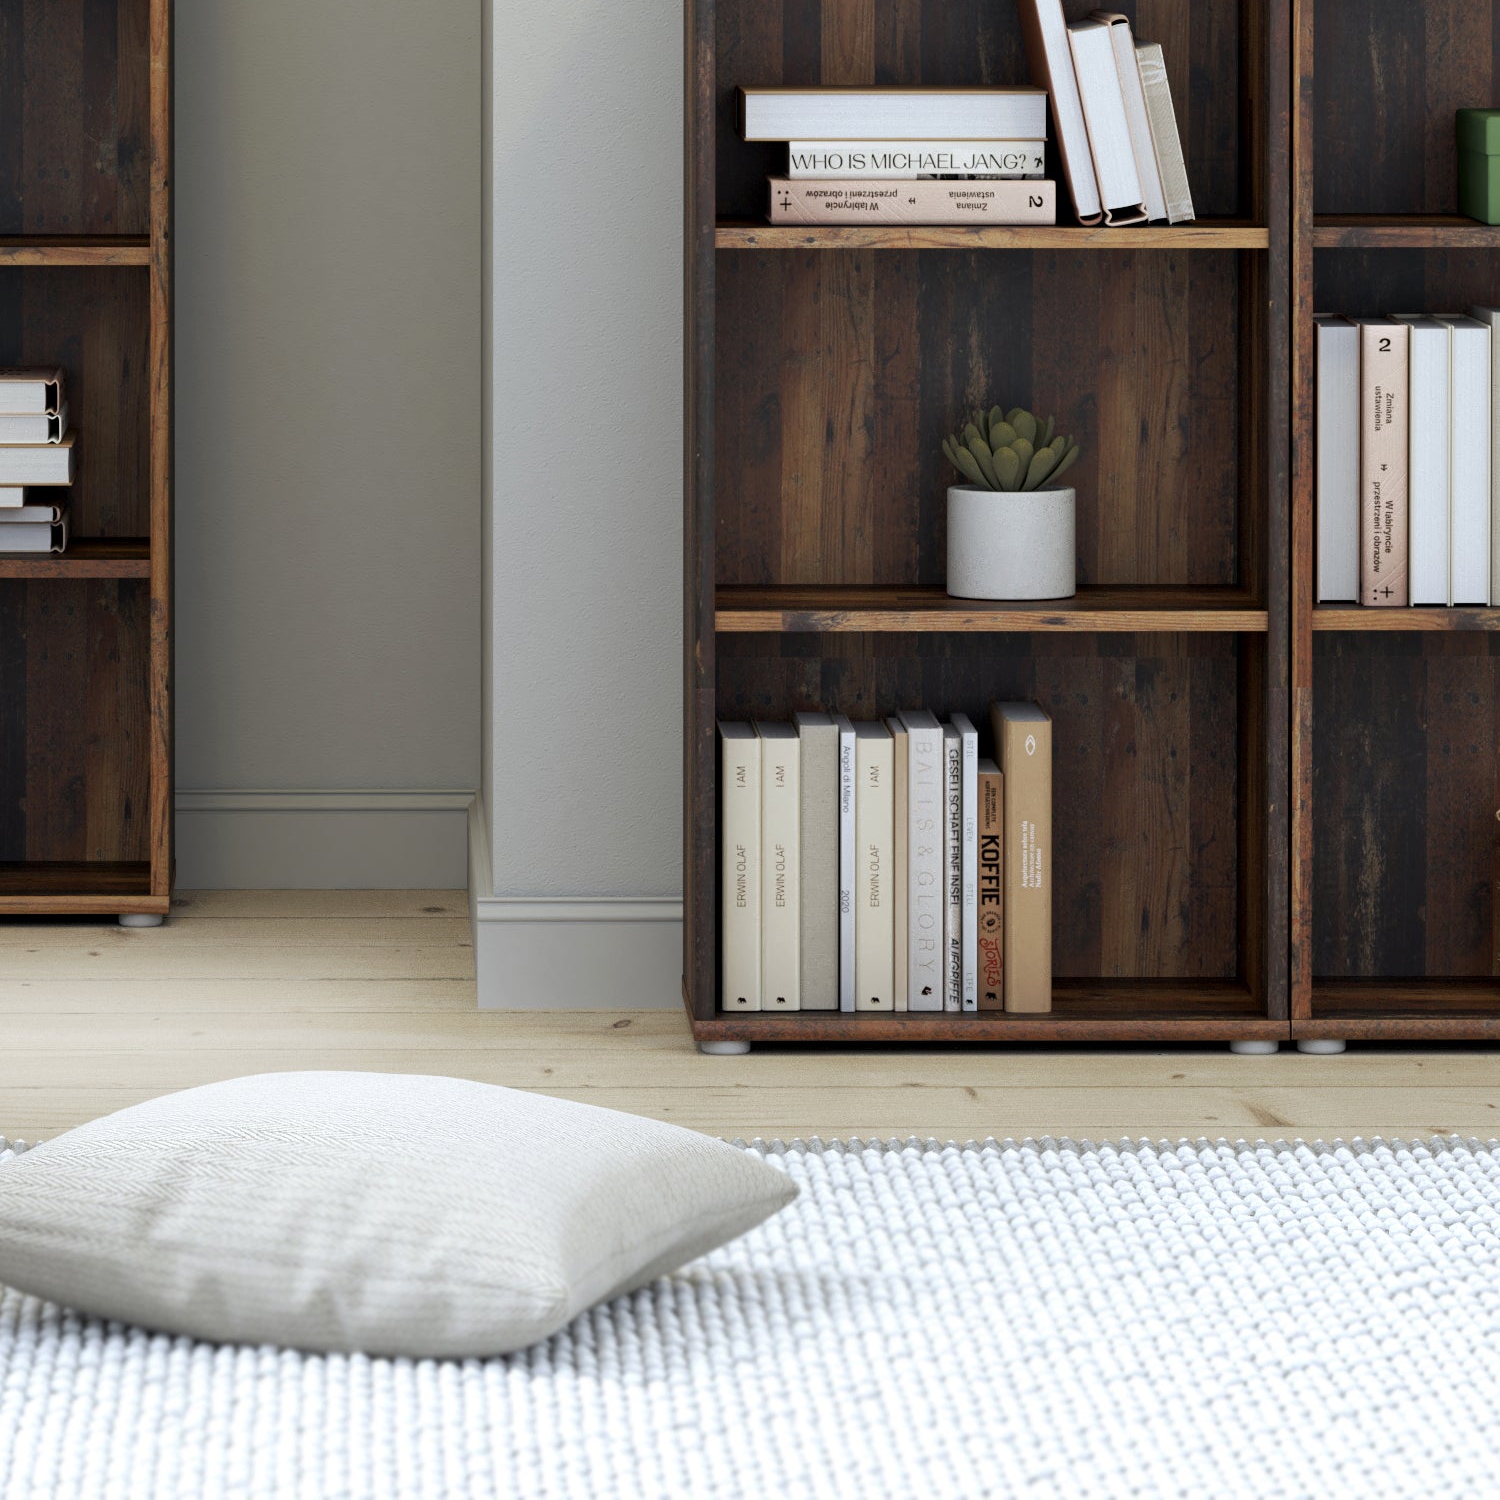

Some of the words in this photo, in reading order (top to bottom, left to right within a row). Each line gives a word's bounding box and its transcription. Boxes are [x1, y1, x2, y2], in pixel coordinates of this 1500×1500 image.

[791, 153, 843, 170] WHO
[848, 153, 866, 170] IS
[871, 153, 961, 169] MICHAEL
[963, 153, 1026, 170] JANG?
[805, 190, 843, 199] obrazów
[825, 201, 868, 211] labiryncie
[849, 189, 898, 198] przestrzeni
[948, 191, 995, 200] ustawienia
[1029, 195, 1044, 208] 2
[869, 202, 879, 211] W
[956, 202, 988, 211] Zmiana
[1378, 338, 1391, 352] 2
[1374, 385, 1383, 432] ustawienia
[1385, 392, 1394, 424] Zmiana
[1372, 481, 1382, 531] przestrzeni
[1385, 500, 1394, 510] W
[1383, 510, 1393, 554] labiryncie
[1372, 535, 1382, 573] obrazów
[842, 745, 851, 773] Angoli
[736, 765, 746, 783] AM
[775, 765, 785, 783] AM
[843, 774, 851, 782] di
[869, 765, 879, 783] AM
[842, 785, 851, 813] Milano
[736, 844, 747, 871] OLAF
[776, 844, 786, 871] OLAF
[870, 844, 880, 871] OLAF
[918, 845, 933, 856] &
[981, 835, 1000, 906] KOFFIE
[736, 873, 747, 908] ERWIN
[776, 873, 786, 908] ERWIN
[841, 890, 850, 913] 2020
[870, 873, 880, 908] ERWIN
[917, 871, 935, 972] GLORY
[979, 937, 1003, 987] STORIES
